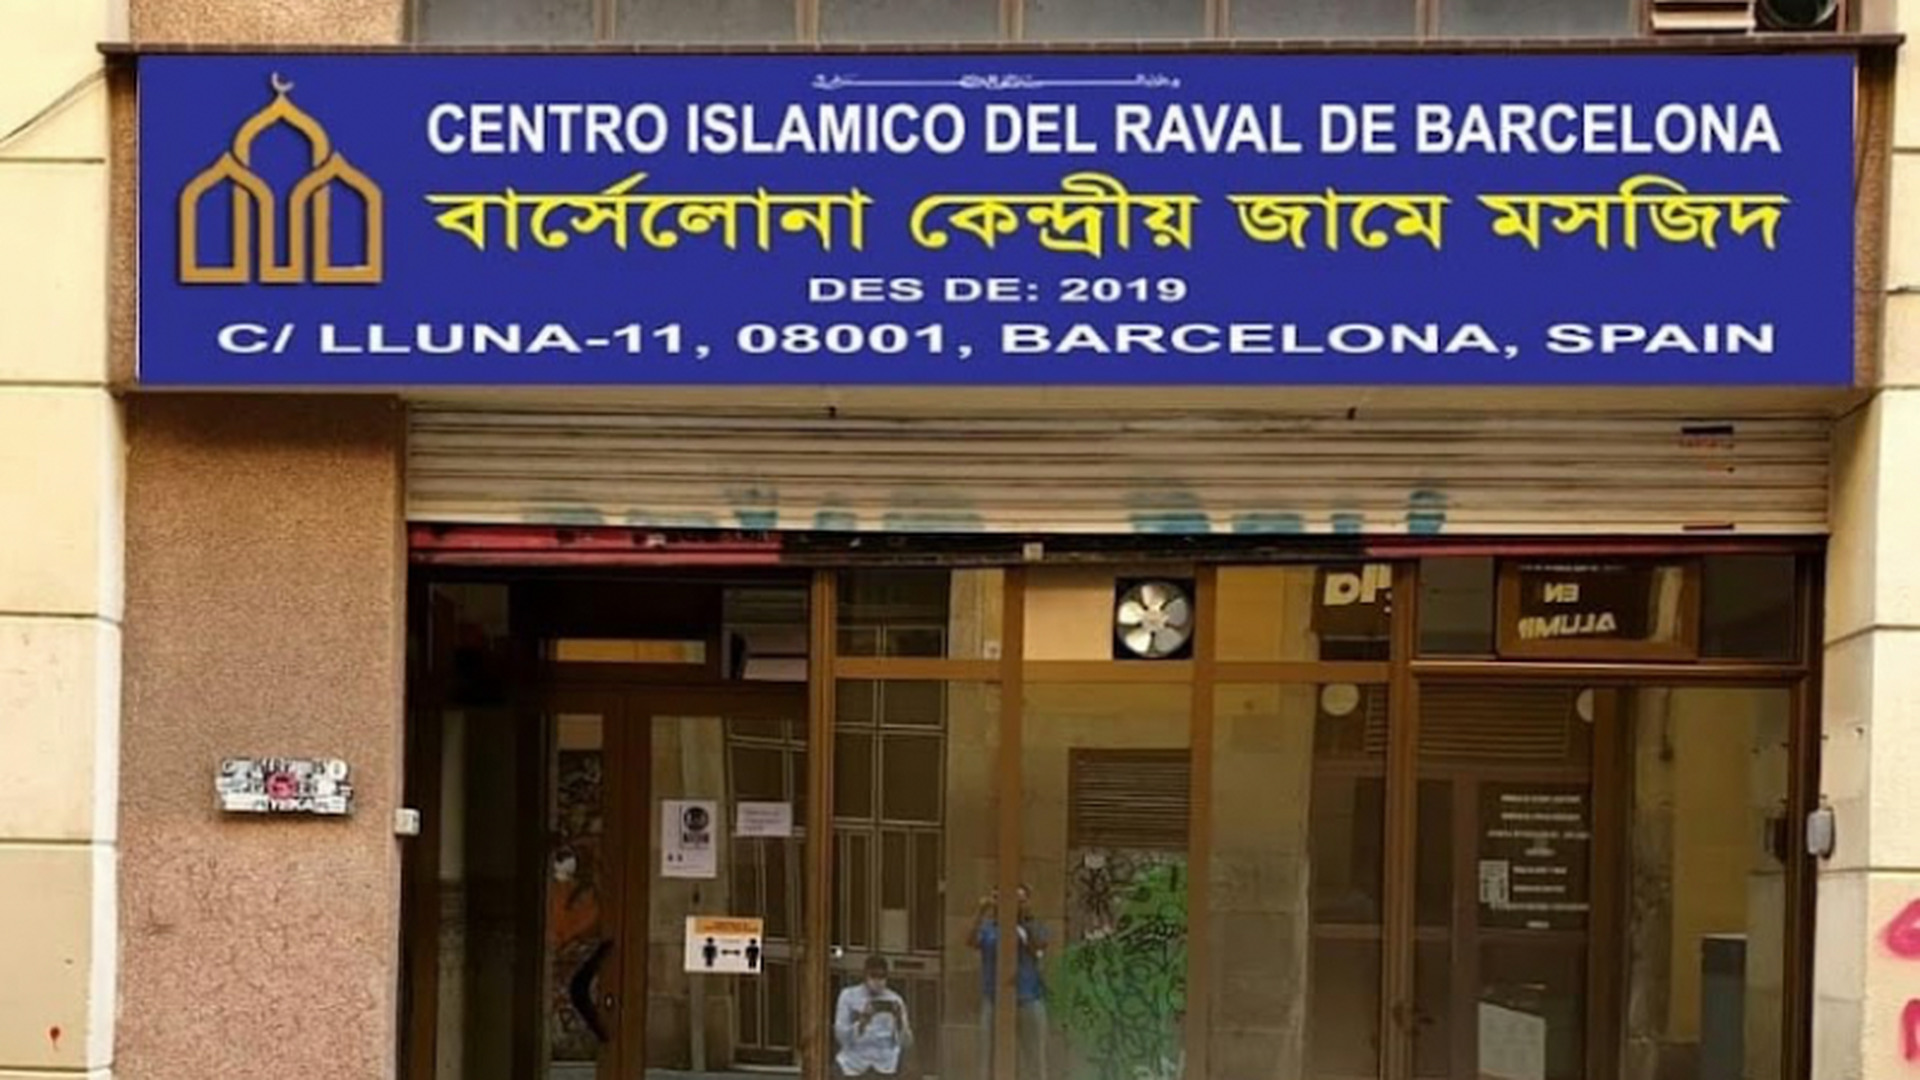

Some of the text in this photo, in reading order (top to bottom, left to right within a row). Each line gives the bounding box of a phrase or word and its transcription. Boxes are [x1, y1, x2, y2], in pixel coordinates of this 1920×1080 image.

[427, 103, 1782, 154] CENTRO ISLAMICO DEL RAVAL DE BARCELONA
[425, 172, 1790, 258] বার্সেলোনা কেন্দ্রীয় জামে মসজিদ
[808, 277, 1188, 302] DES DE: 2019
[217, 323, 1773, 359] C/ LLUNA-11, 08001, BARCELONA, SPAIN
